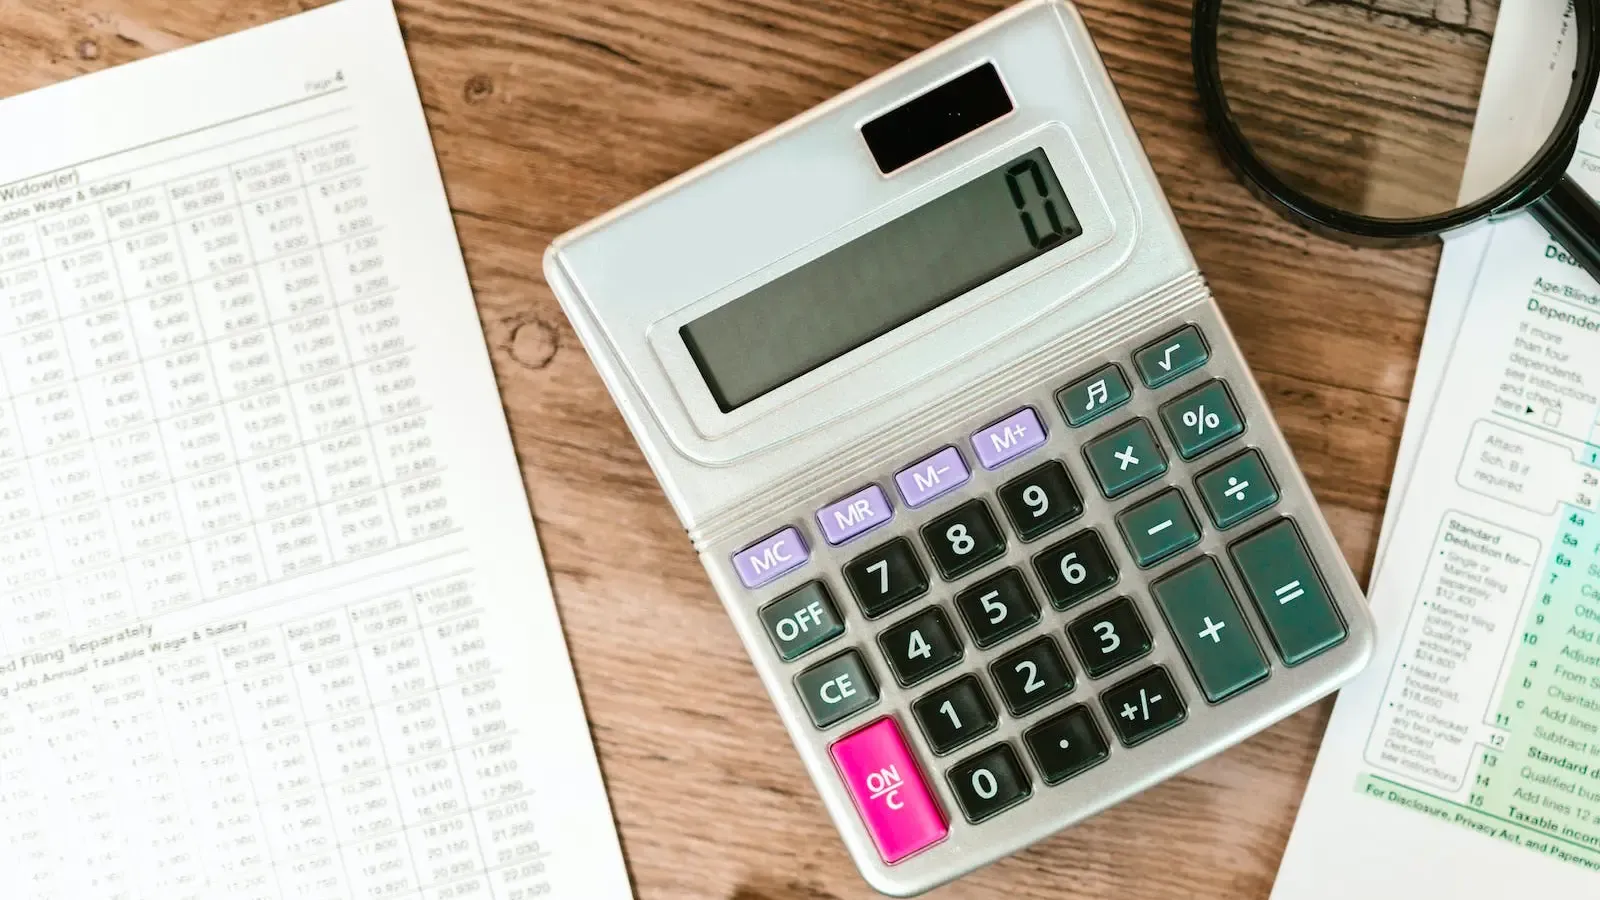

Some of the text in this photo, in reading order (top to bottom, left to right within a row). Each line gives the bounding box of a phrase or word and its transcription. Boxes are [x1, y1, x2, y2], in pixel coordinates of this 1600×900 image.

[0, 169, 79, 201] Widow(er)
[33, 196, 73, 214] Wage
[90, 178, 132, 197] Salary
[1514, 336, 1570, 362] than four
[1530, 327, 1562, 344] more
[1503, 367, 1526, 381] see
[1495, 395, 1523, 411] here
[1499, 382, 1562, 410] and check
[1182, 404, 1220, 435] %
[990, 423, 1027, 453] M+
[1484, 435, 1524, 454] Attach
[833, 498, 875, 531] MR
[1022, 484, 1049, 518] 9
[1449, 519, 1501, 545] Standard
[1569, 513, 1585, 527] 4a
[945, 523, 976, 556] 8
[1444, 532, 1502, 560] Deduction
[1562, 533, 1578, 548] 5a
[749, 539, 793, 575] MC
[1060, 552, 1087, 585] 6
[1448, 551, 1478, 568] Single
[1556, 553, 1572, 568] 6a
[866, 559, 890, 594] 7
[1444, 562, 1508, 594] Married filing
[1550, 572, 1559, 584] 7
[979, 590, 1008, 625] 5
[1542, 593, 1551, 605] 8
[775, 600, 826, 642] OFF
[1431, 602, 1496, 633] Married filing
[1536, 614, 1545, 626] 9
[21, 650, 65, 670] Filing
[68, 624, 153, 655] Separately
[906, 629, 932, 661] 4
[1092, 621, 1121, 654] 3
[1523, 631, 1538, 645] 10
[1567, 624, 1594, 643] Add
[13, 677, 38, 693] Job
[42, 663, 89, 683] Annual
[93, 648, 146, 669] Taxable
[149, 640, 188, 655] Wage
[205, 620, 248, 638] Salary
[1529, 659, 1538, 669] a
[1015, 660, 1046, 695] 2
[1410, 664, 1437, 680] Head
[1523, 676, 1532, 689] b
[1554, 664, 1587, 685] From
[819, 672, 857, 705] CE
[938, 700, 962, 730] 1
[1120, 688, 1162, 721] +/-
[1412, 720, 1431, 734] box
[1433, 731, 1463, 745] under
[1425, 714, 1469, 735] checked
[1496, 713, 1509, 726] 11
[1540, 706, 1599, 734] Add lines
[1490, 734, 1505, 747] 12
[1533, 726, 1587, 754] Subtract
[1483, 753, 1498, 768] 13
[1527, 746, 1587, 776] Standard
[866, 763, 902, 794] ON
[971, 768, 998, 800] 0
[1476, 773, 1490, 788] 14
[1520, 766, 1576, 794] Qualified
[886, 790, 904, 811] C
[1469, 793, 1485, 808] 15
[1512, 787, 1541, 805] Add
[1542, 798, 1571, 816] lines
[1576, 807, 1591, 821] 12
[1366, 783, 1385, 798] For
[1388, 791, 1452, 823] Disclosure,
[1455, 812, 1497, 837] Privacy
[1500, 829, 1523, 845] Act,
[1525, 838, 1548, 853] and
[1508, 805, 1559, 832] Taxable
